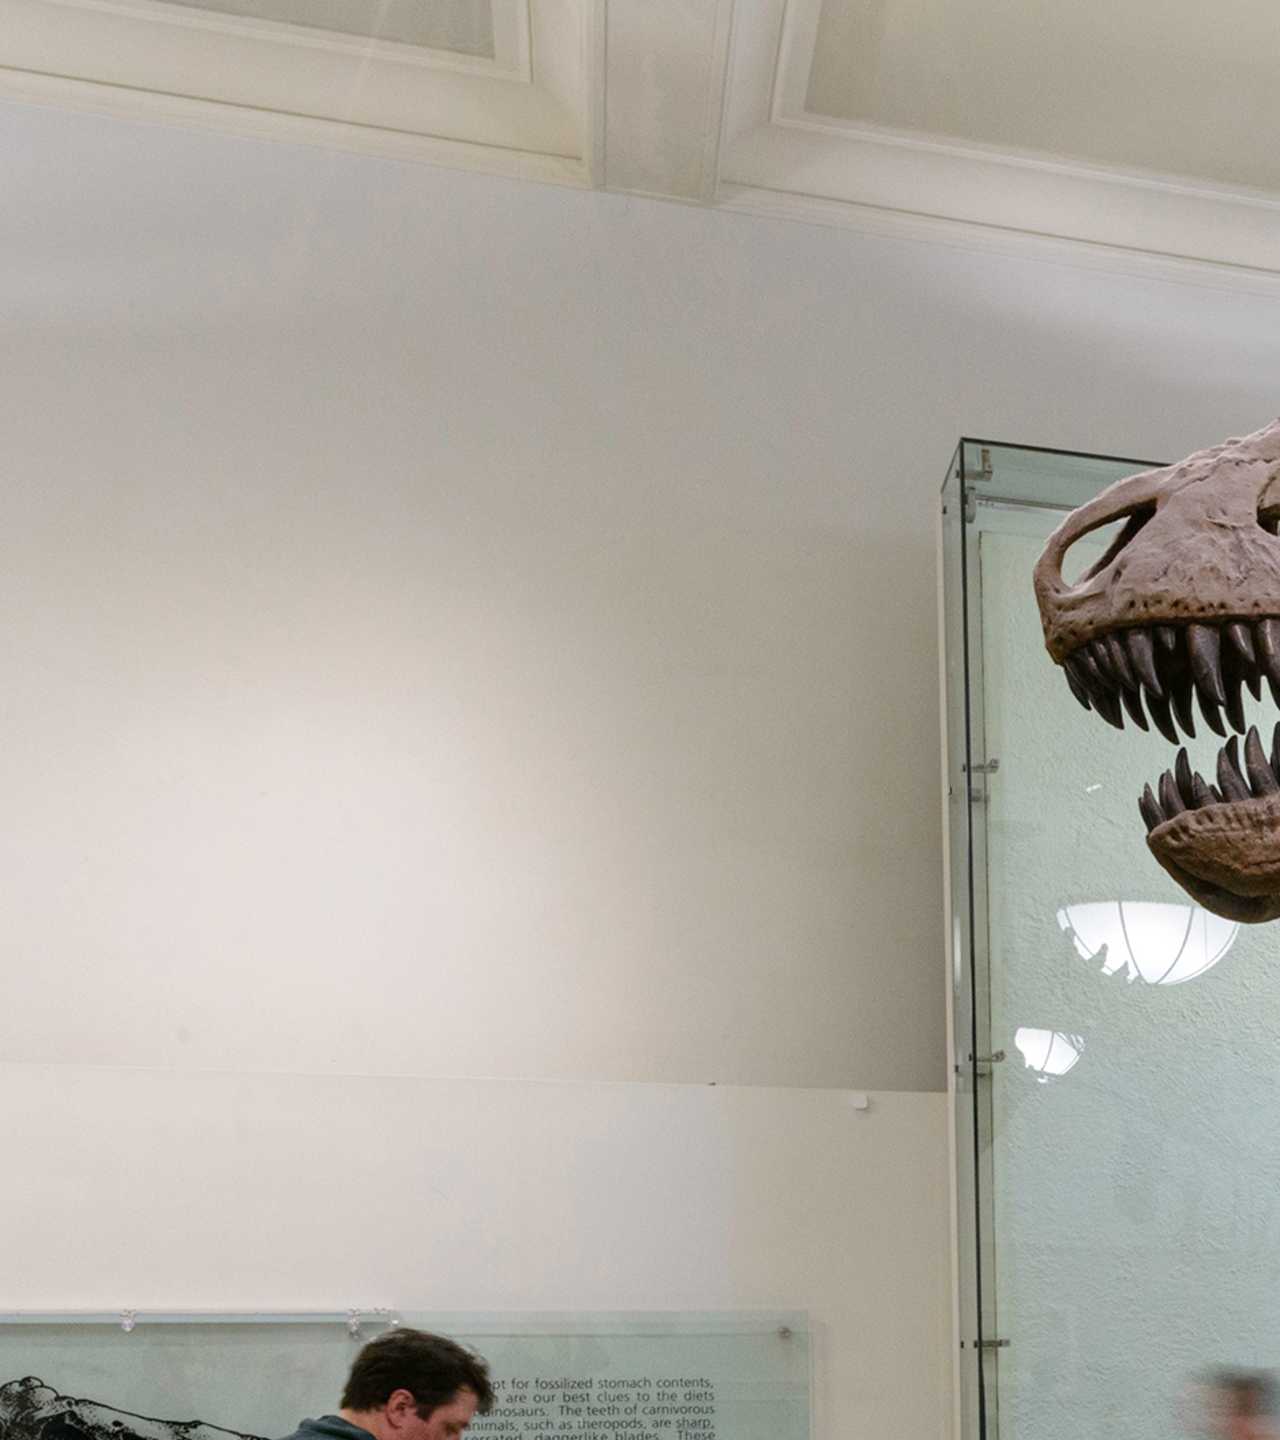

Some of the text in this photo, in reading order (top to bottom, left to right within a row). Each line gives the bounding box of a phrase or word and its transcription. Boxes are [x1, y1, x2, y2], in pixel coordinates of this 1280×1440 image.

[512, 1379, 529, 1389] for
[536, 1378, 592, 1389] fossilized
[598, 1378, 651, 1389] stomach
[656, 1378, 714, 1389] contents,
[506, 1393, 526, 1403] are
[533, 1393, 556, 1402] our
[563, 1392, 589, 1402] best
[597, 1391, 629, 1402] clues
[637, 1392, 649, 1401] to
[657, 1391, 677, 1401] the
[684, 1390, 714, 1401] diets
[560, 1406, 581, 1416] The
[587, 1405, 620, 1416] teeth
[625, 1405, 637, 1415] of
[642, 1405, 714, 1415] carnivorous
[524, 1419, 553, 1430] such
[558, 1421, 572, 1430] as
[577, 1418, 647, 1431] theropods,
[652, 1419, 671, 1428] are
[676, 1418, 714, 1431] sharp,
[678, 1431, 715, 1440] These
